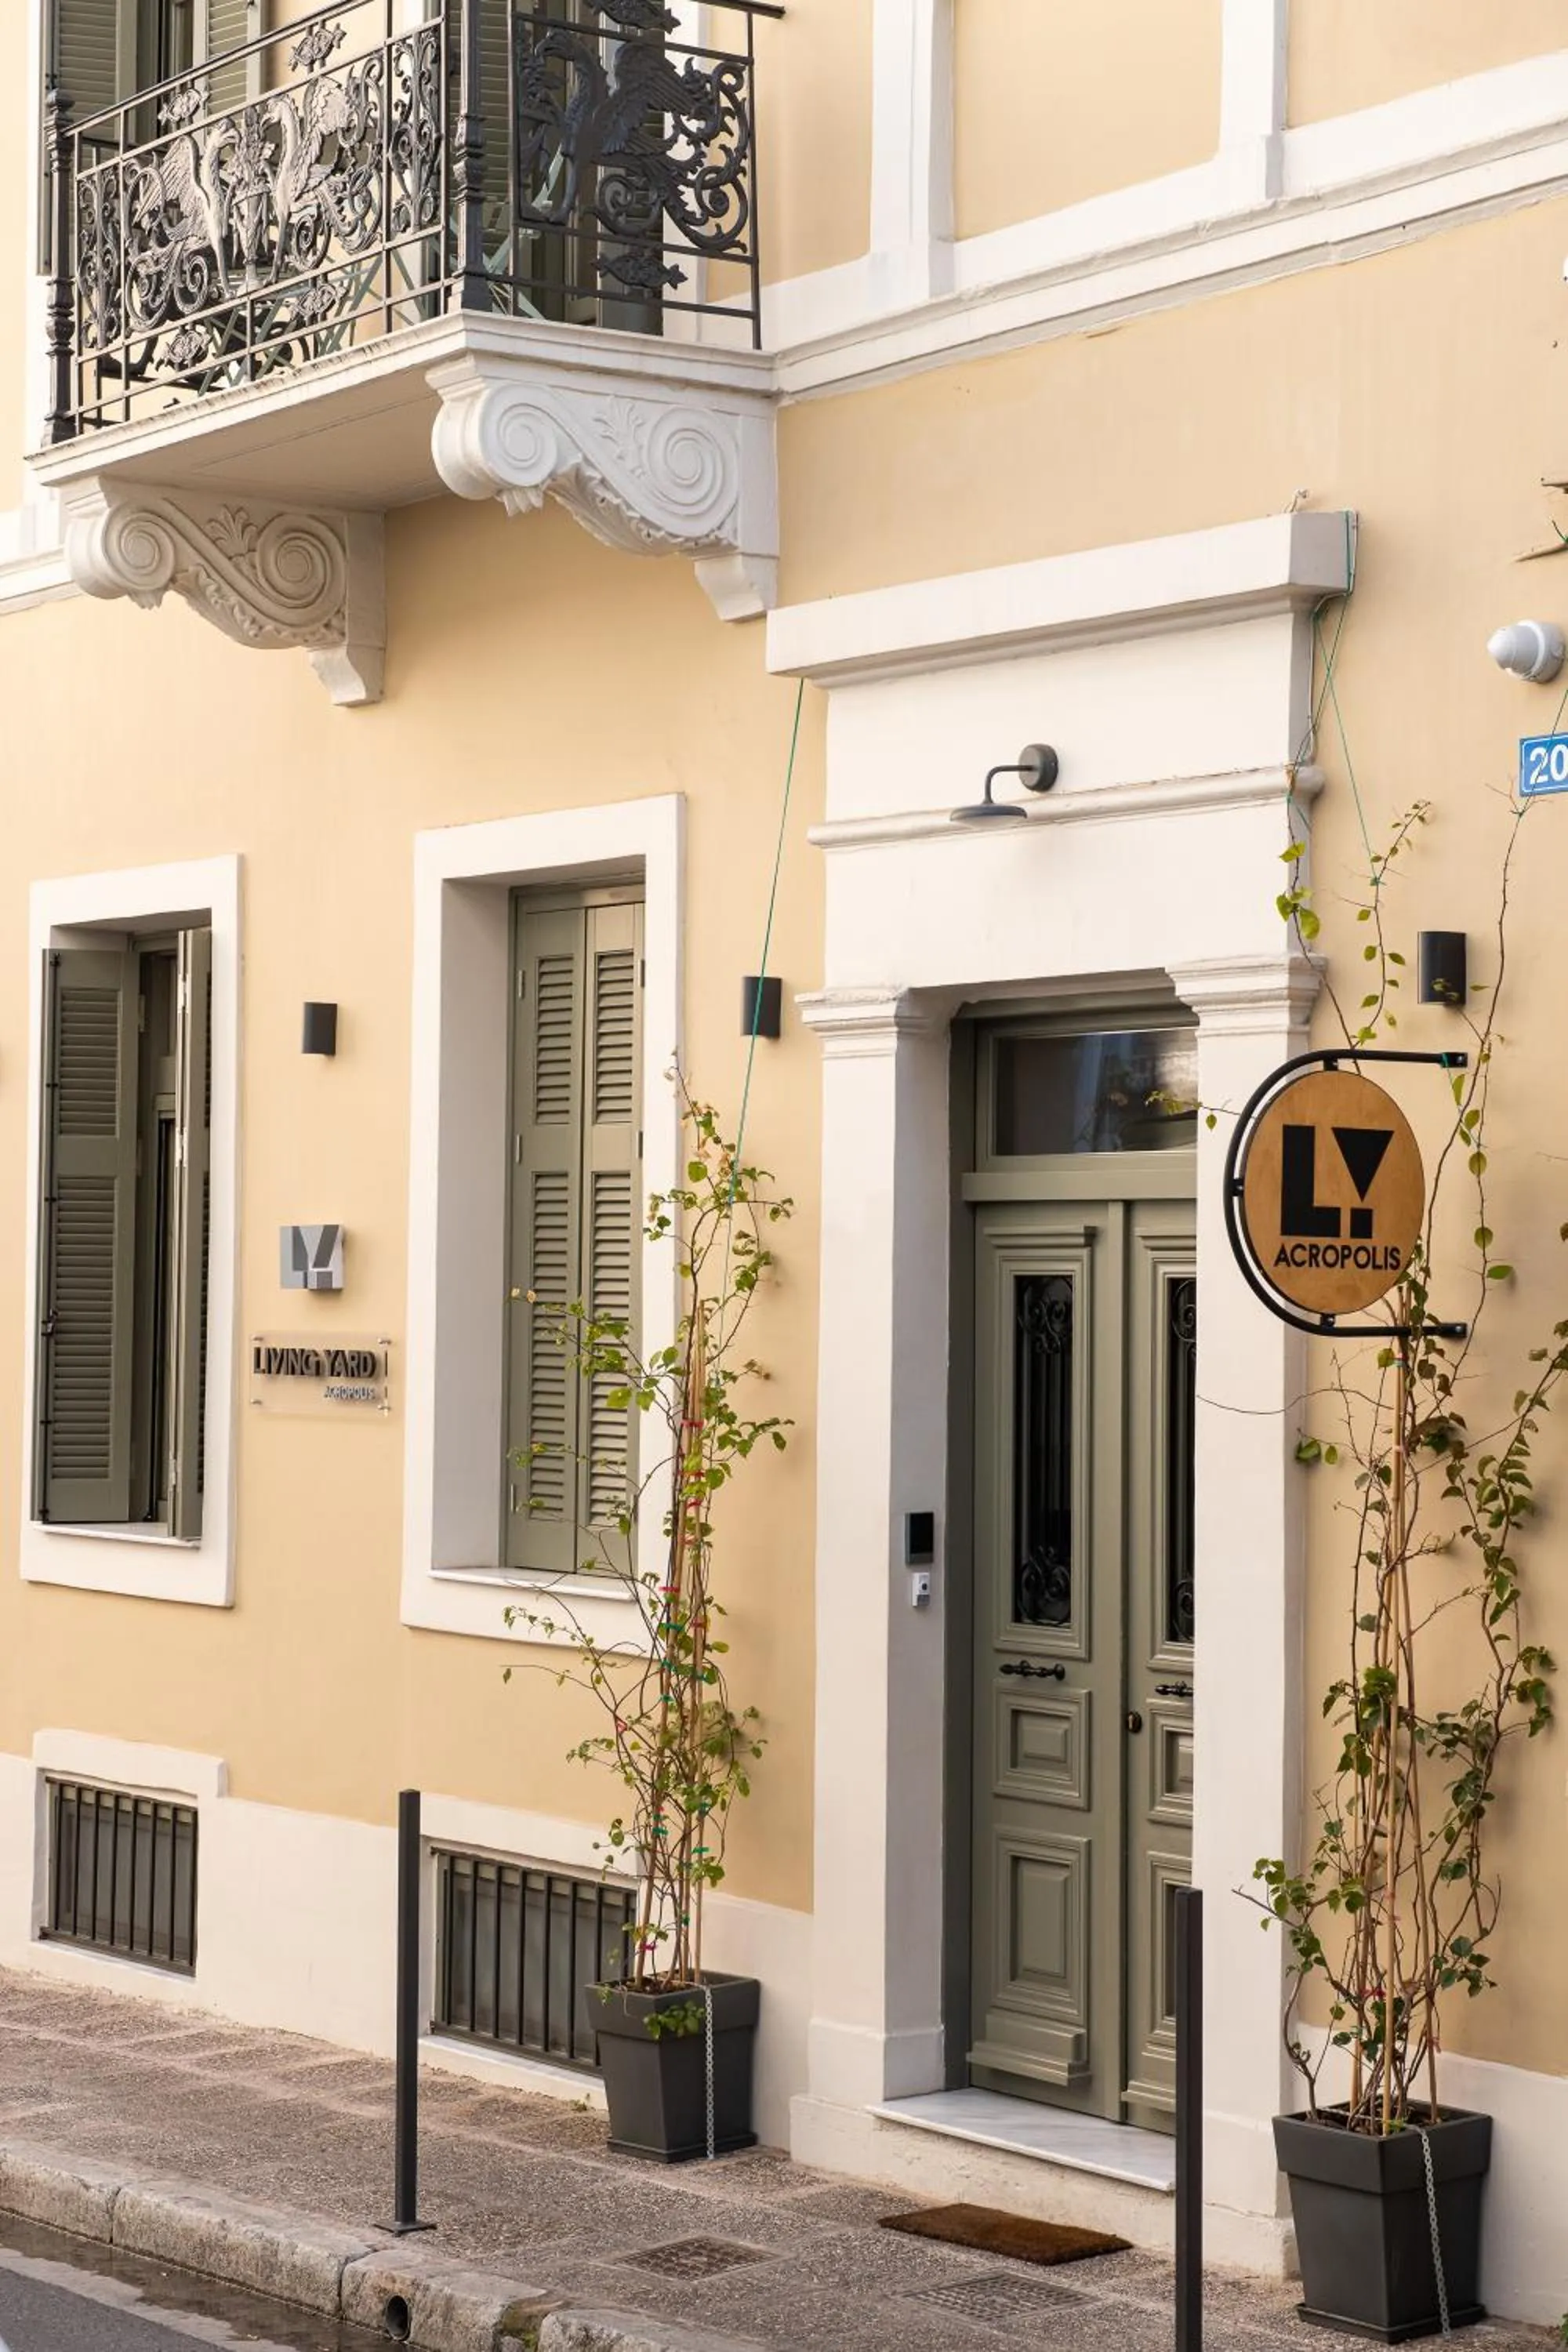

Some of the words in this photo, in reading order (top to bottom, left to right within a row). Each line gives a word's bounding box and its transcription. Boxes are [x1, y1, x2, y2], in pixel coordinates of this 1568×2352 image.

[1530, 744, 1568, 785] 20
[1274, 1243, 1402, 1270] ACROPOLIS
[253, 1346, 321, 1377] LIVING
[325, 1349, 377, 1377] YARD
